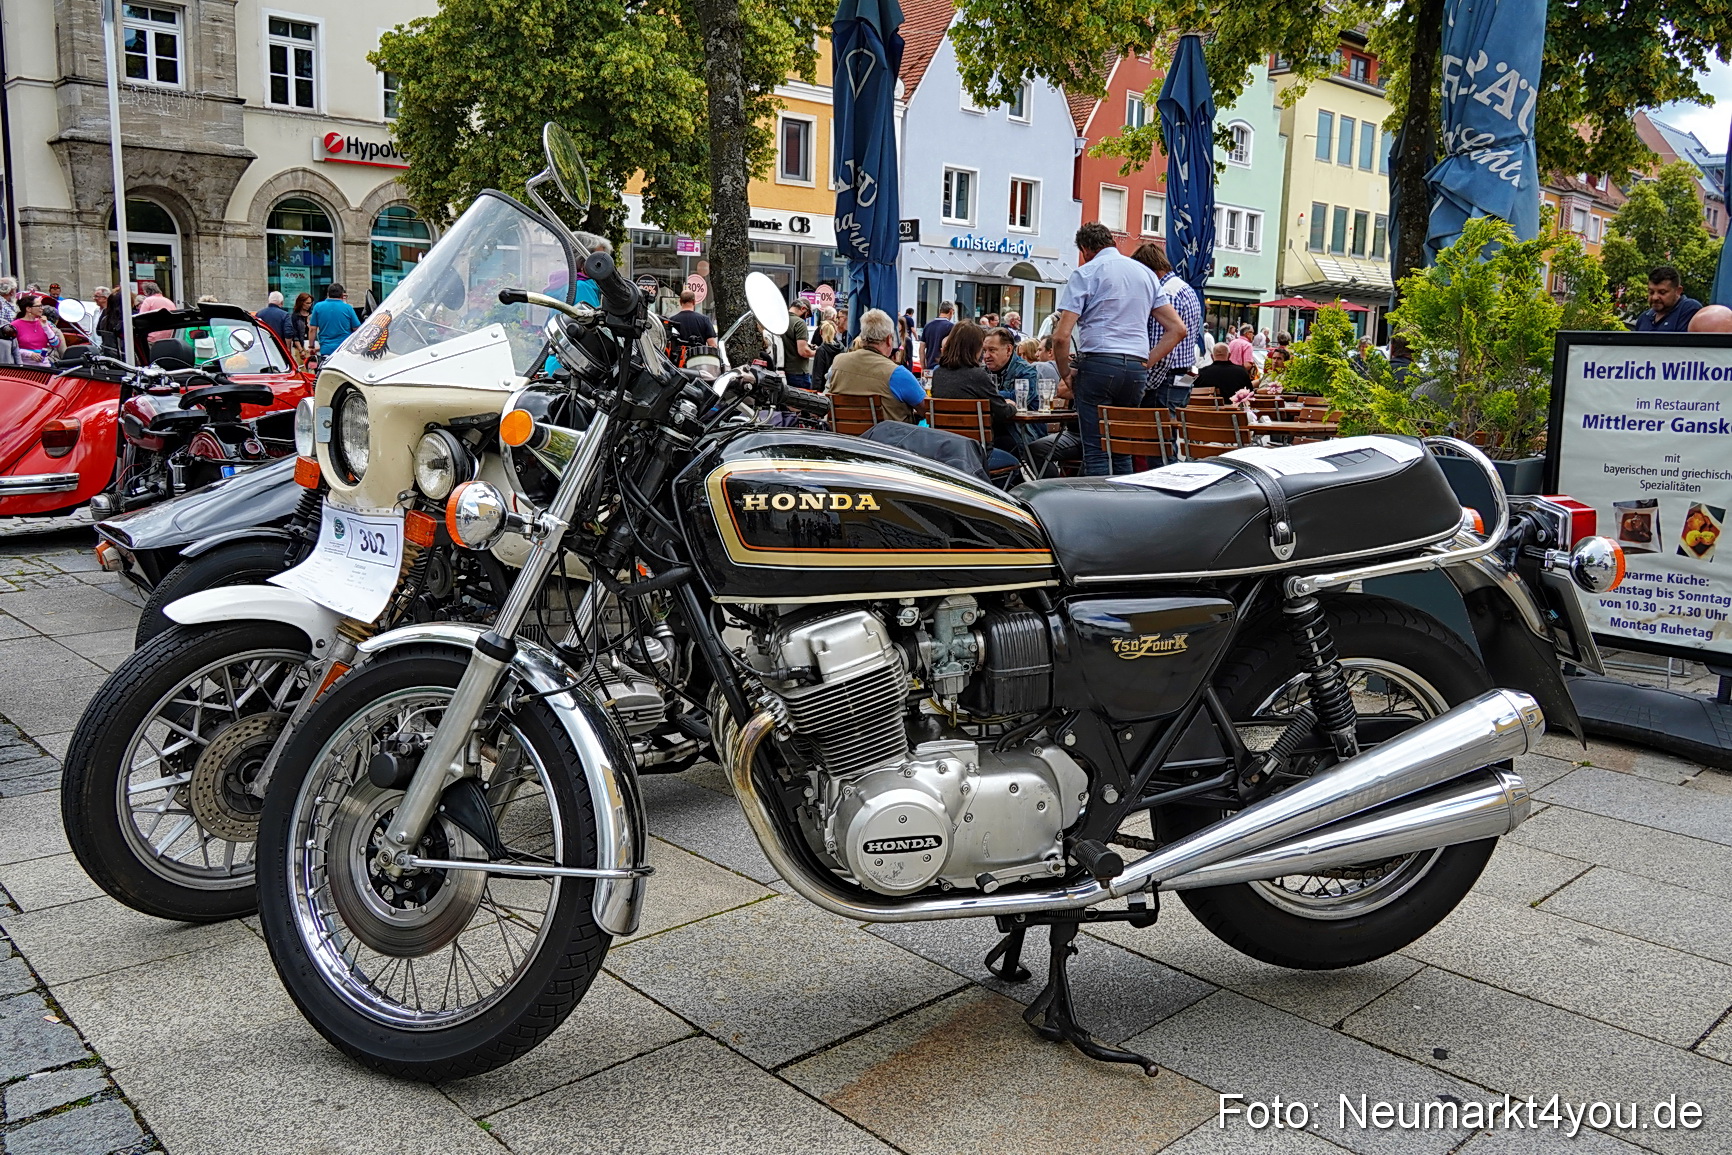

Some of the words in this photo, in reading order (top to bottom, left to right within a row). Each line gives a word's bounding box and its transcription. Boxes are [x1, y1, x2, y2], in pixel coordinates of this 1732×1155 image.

[789, 215, 811, 234] CB
[899, 222, 912, 235] CB
[820, 292, 833, 302] 0%
[1583, 361, 1656, 380] Herzlich
[1636, 398, 1650, 410] im
[1655, 399, 1721, 412] Restaurant
[1582, 414, 1665, 431] Mittlerer
[1664, 454, 1680, 463] mit
[1603, 463, 1658, 476] bayerischen
[1660, 467, 1679, 477] und
[1640, 480, 1701, 492] Spezialitäten
[742, 492, 881, 512] HONDA
[359, 528, 389, 556] 302
[1624, 571, 1663, 582] warme
[1667, 573, 1710, 587] Küche:
[1656, 587, 1674, 599] bis
[1678, 590, 1732, 608] Sonntag
[1599, 599, 1622, 609] von
[1625, 600, 1657, 613] 10.30
[1668, 604, 1702, 618] 21.30
[1705, 608, 1728, 621] Uhr
[1610, 617, 1657, 634] Montag
[1661, 623, 1714, 641] Ruhetag
[867, 837, 939, 853] HONDA
